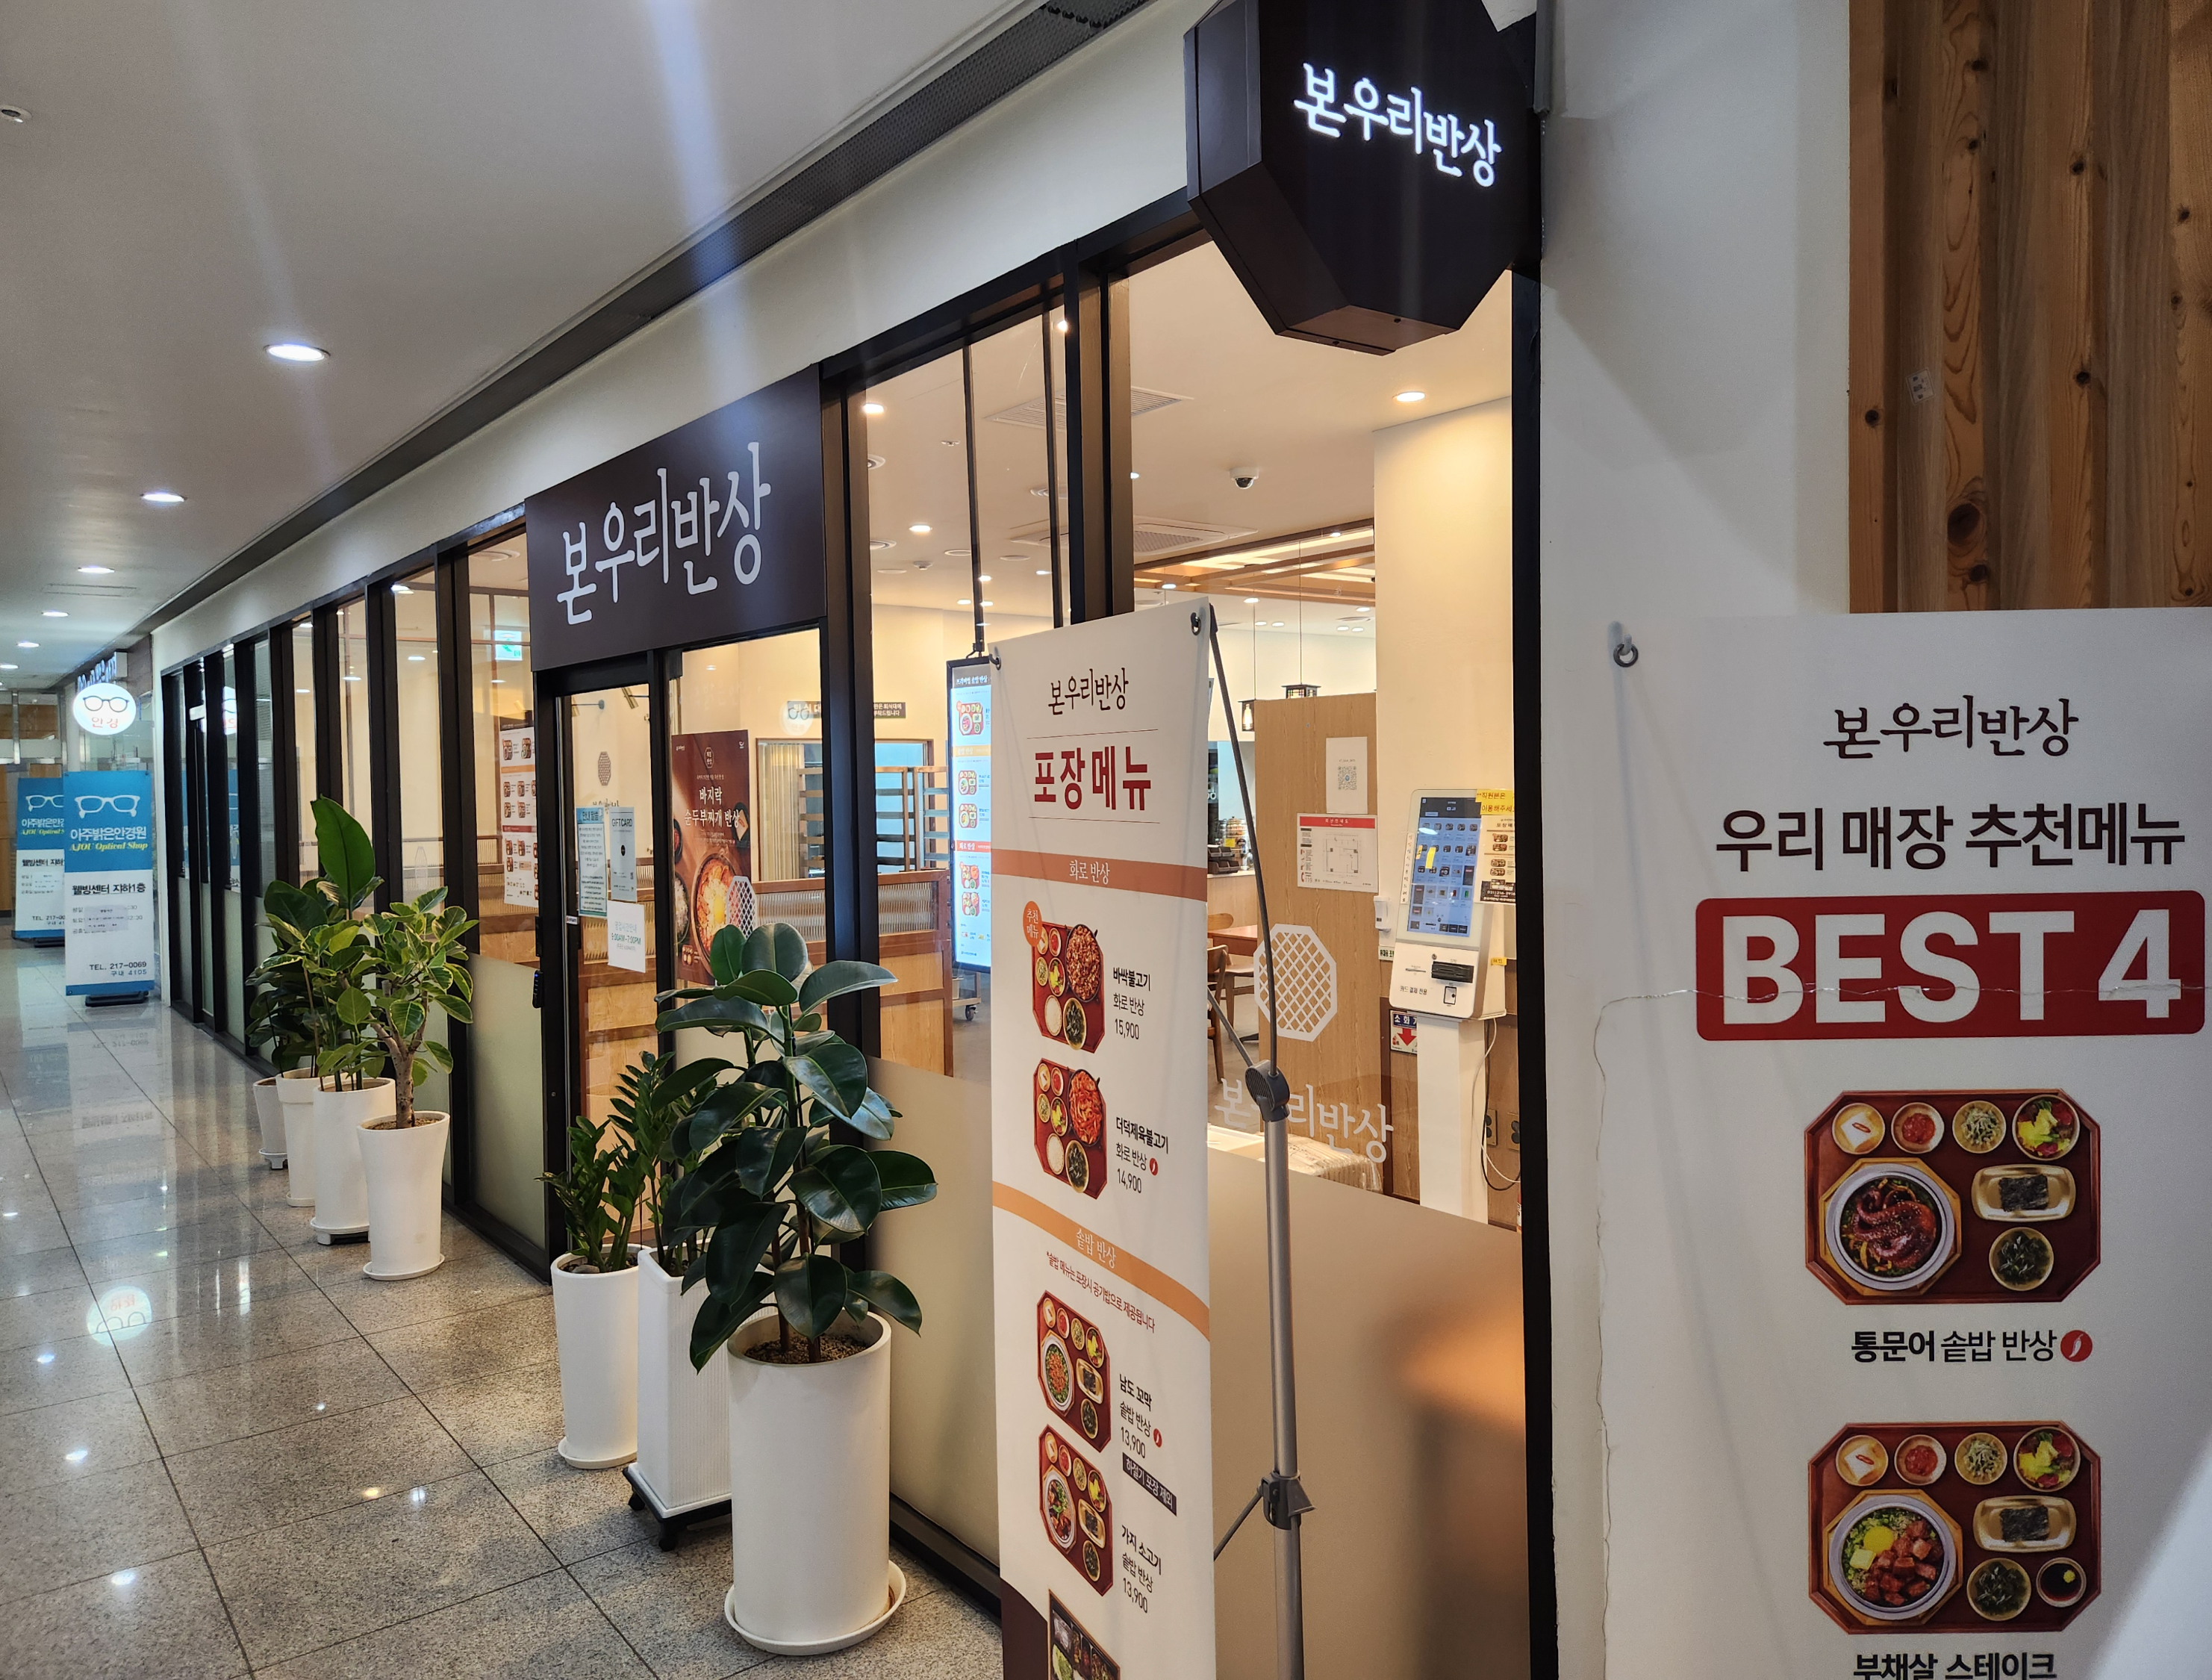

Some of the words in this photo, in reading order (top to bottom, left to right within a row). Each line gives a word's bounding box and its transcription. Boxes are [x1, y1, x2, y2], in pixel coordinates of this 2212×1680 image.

[1294, 62, 1502, 187] 본우리반상
[557, 442, 771, 625] 본우리반상
[1048, 668, 1129, 715] 본우리반상
[91, 717, 118, 729] 안경
[1823, 694, 2079, 759] 본우리반상
[1035, 746, 1151, 810] 포장메뉴
[700, 786, 723, 806] 바지락
[71, 826, 147, 841] 아주밝은안경원
[685, 809, 722, 828] 순두부찌개
[724, 809, 740, 828] 반상
[96, 843, 125, 852] Optical
[128, 841, 148, 850] Shop
[1716, 807, 1823, 871] 우리
[1842, 805, 1954, 870] 매장
[1966, 802, 2185, 868] 추천메뉴
[50, 858, 64, 866] 지하
[1070, 859, 1087, 880] 화로
[1091, 861, 1110, 884] 반상
[72, 884, 110, 895] 웰빙센터
[113, 883, 146, 894] 지하1층
[1026, 908, 1039, 924] 추천
[1026, 924, 1039, 939] 메뉴
[110, 961, 147, 970] 217-0069
[1113, 967, 1150, 991] 바싹불고기
[1723, 910, 2075, 1024] BEST
[2098, 909, 2182, 1018] 4
[1113, 994, 1128, 1012] 화로
[1130, 997, 1144, 1016] 반상
[1115, 1018, 1140, 1040] 15,900
[1116, 1116, 1168, 1154] 더덕제육불고기
[1215, 1077, 1394, 1163] 본리반상
[1116, 1142, 1130, 1162] 화로
[1132, 1148, 1147, 1171] 반상
[1117, 1167, 1141, 1194] 14,900
[1077, 1228, 1094, 1256] 솥밥
[1097, 1241, 1116, 1269] 반상
[1059, 1260, 1076, 1281] 메뉴는
[1077, 1270, 1092, 1293] 포장시
[1093, 1282, 1123, 1311] 공기밥으로
[1123, 1300, 1156, 1334] 제공됩니다
[1851, 1331, 1936, 1363] 통문어
[1940, 1331, 1996, 1363] 솥밥
[2001, 1330, 2057, 1361] 반상
[1120, 1373, 1135, 1397] 남도
[1136, 1388, 1152, 1411] 꼬막
[1120, 1401, 1135, 1425] 솥밥
[1135, 1413, 1151, 1437] 반상
[1121, 1426, 1146, 1459] 13,900
[1126, 1457, 1144, 1484] 하절기
[1145, 1475, 1159, 1498] 포장
[1159, 1487, 1174, 1510] 제외
[1122, 1525, 1137, 1552] 가지
[1138, 1542, 1162, 1575] 소고기
[1122, 1552, 1137, 1576] 솥밥
[1138, 1567, 1153, 1593] 반상
[1123, 1577, 1148, 1614] 13,900
[1853, 1652, 1938, 1680] 부채살
[1945, 1652, 2057, 1680] 스테이크
